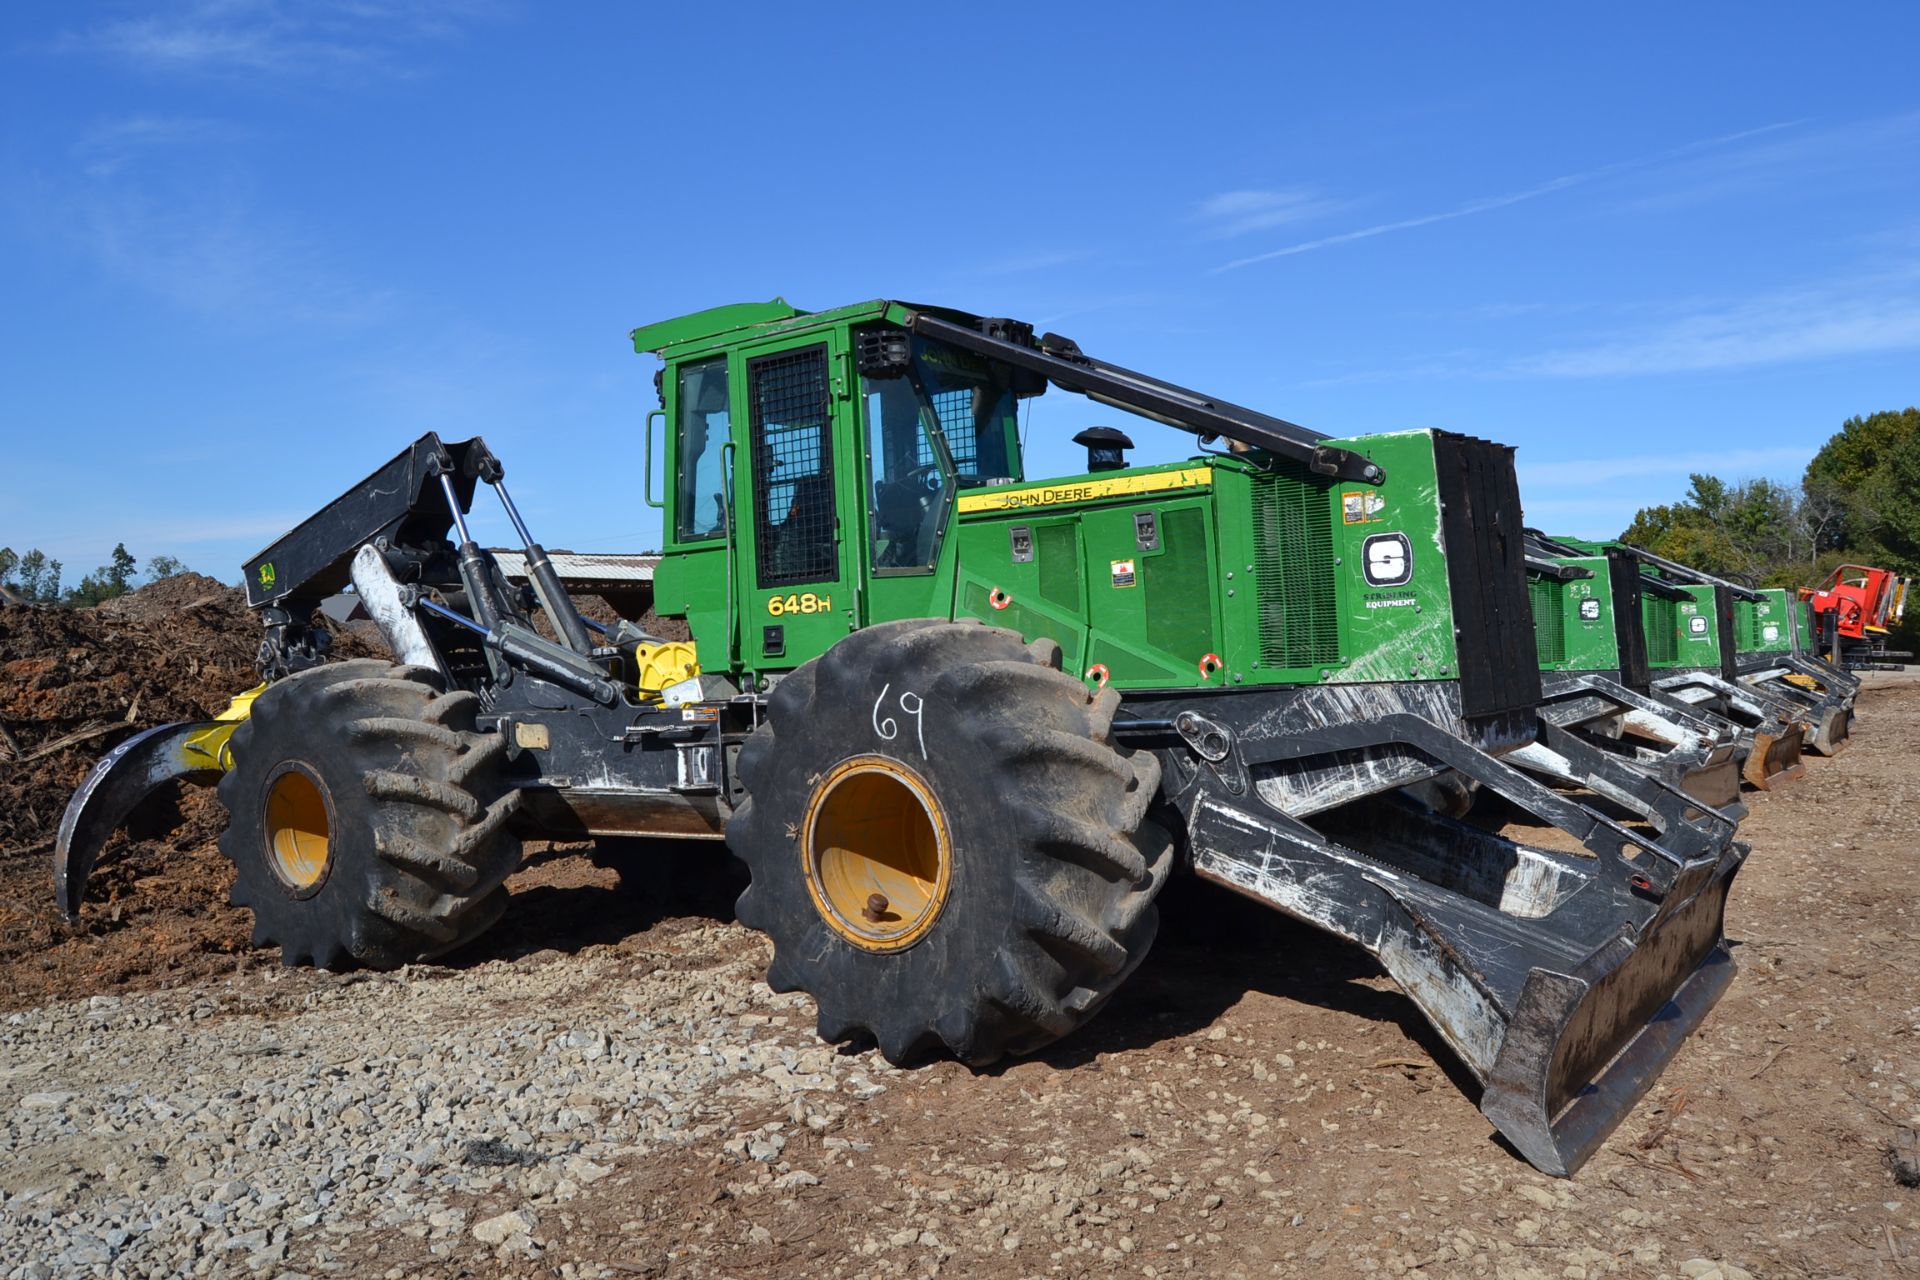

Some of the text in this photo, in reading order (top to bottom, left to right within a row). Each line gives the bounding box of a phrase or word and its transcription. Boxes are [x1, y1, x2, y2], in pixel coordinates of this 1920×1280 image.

[1001, 487, 1092, 507] JOHN DEERE
[768, 592, 832, 616] 648H
[1365, 598, 1416, 609] EQUIPMENT
[872, 683, 927, 760] 69
